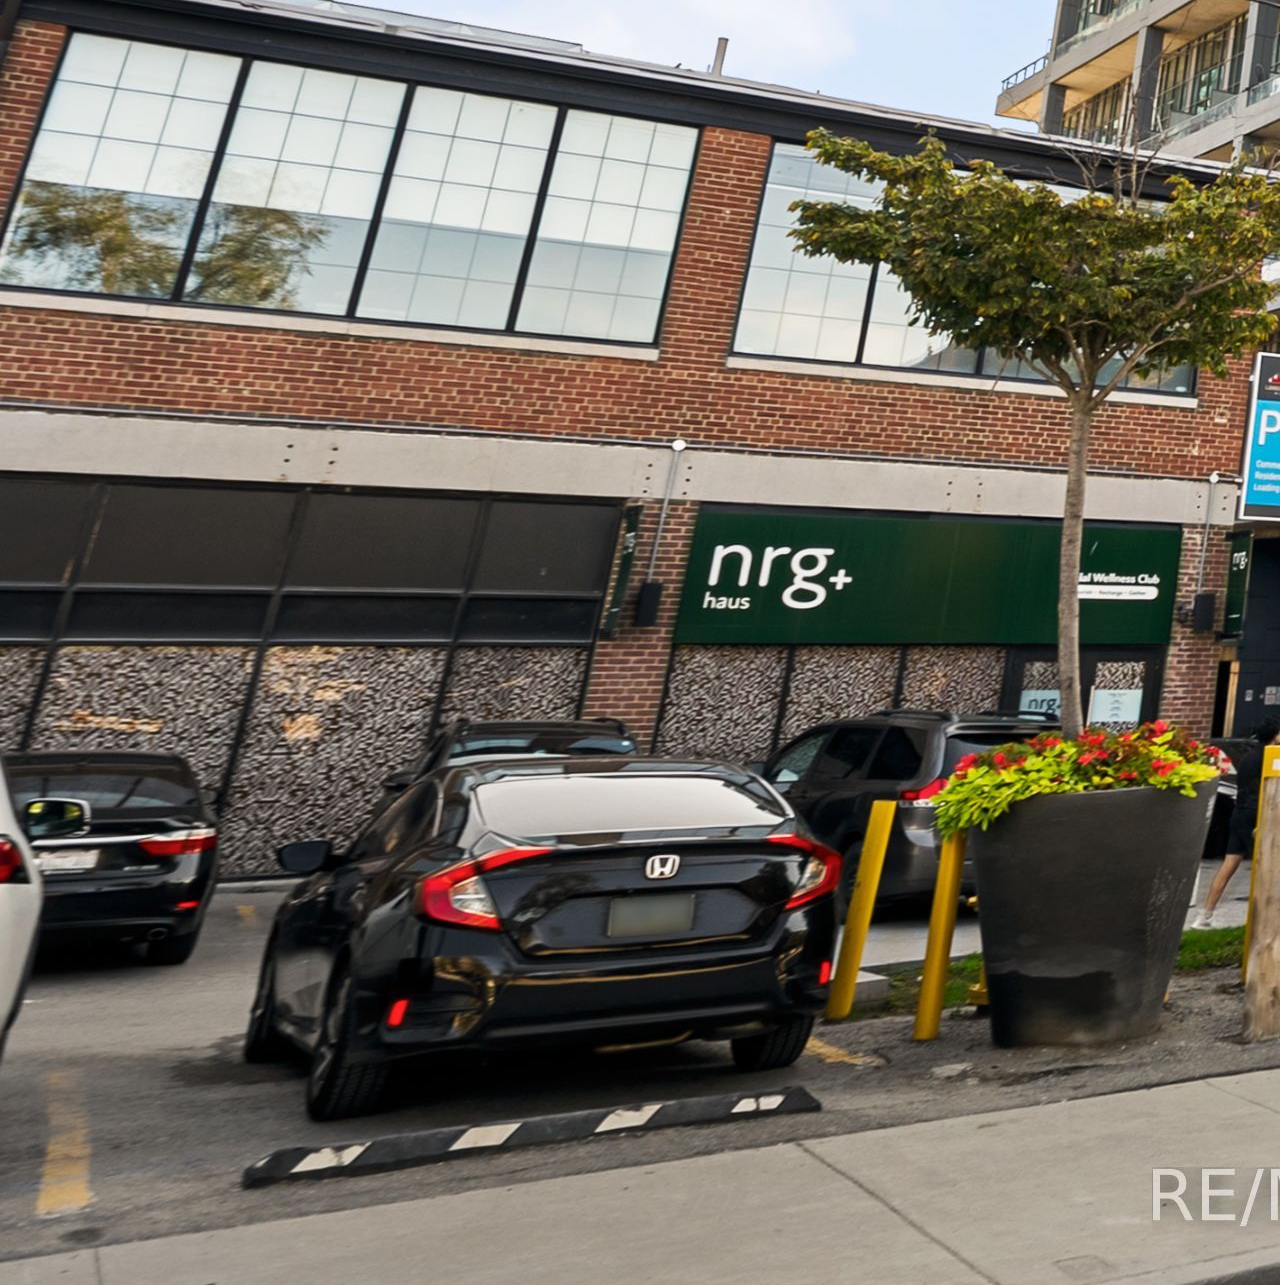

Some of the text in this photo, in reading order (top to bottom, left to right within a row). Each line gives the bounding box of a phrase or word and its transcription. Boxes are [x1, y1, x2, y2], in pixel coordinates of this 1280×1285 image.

[1253, 483, 1280, 494] Loading
[1093, 573, 1136, 584] Wellness
[1137, 574, 1160, 585] Club
[702, 591, 751, 609] haus
